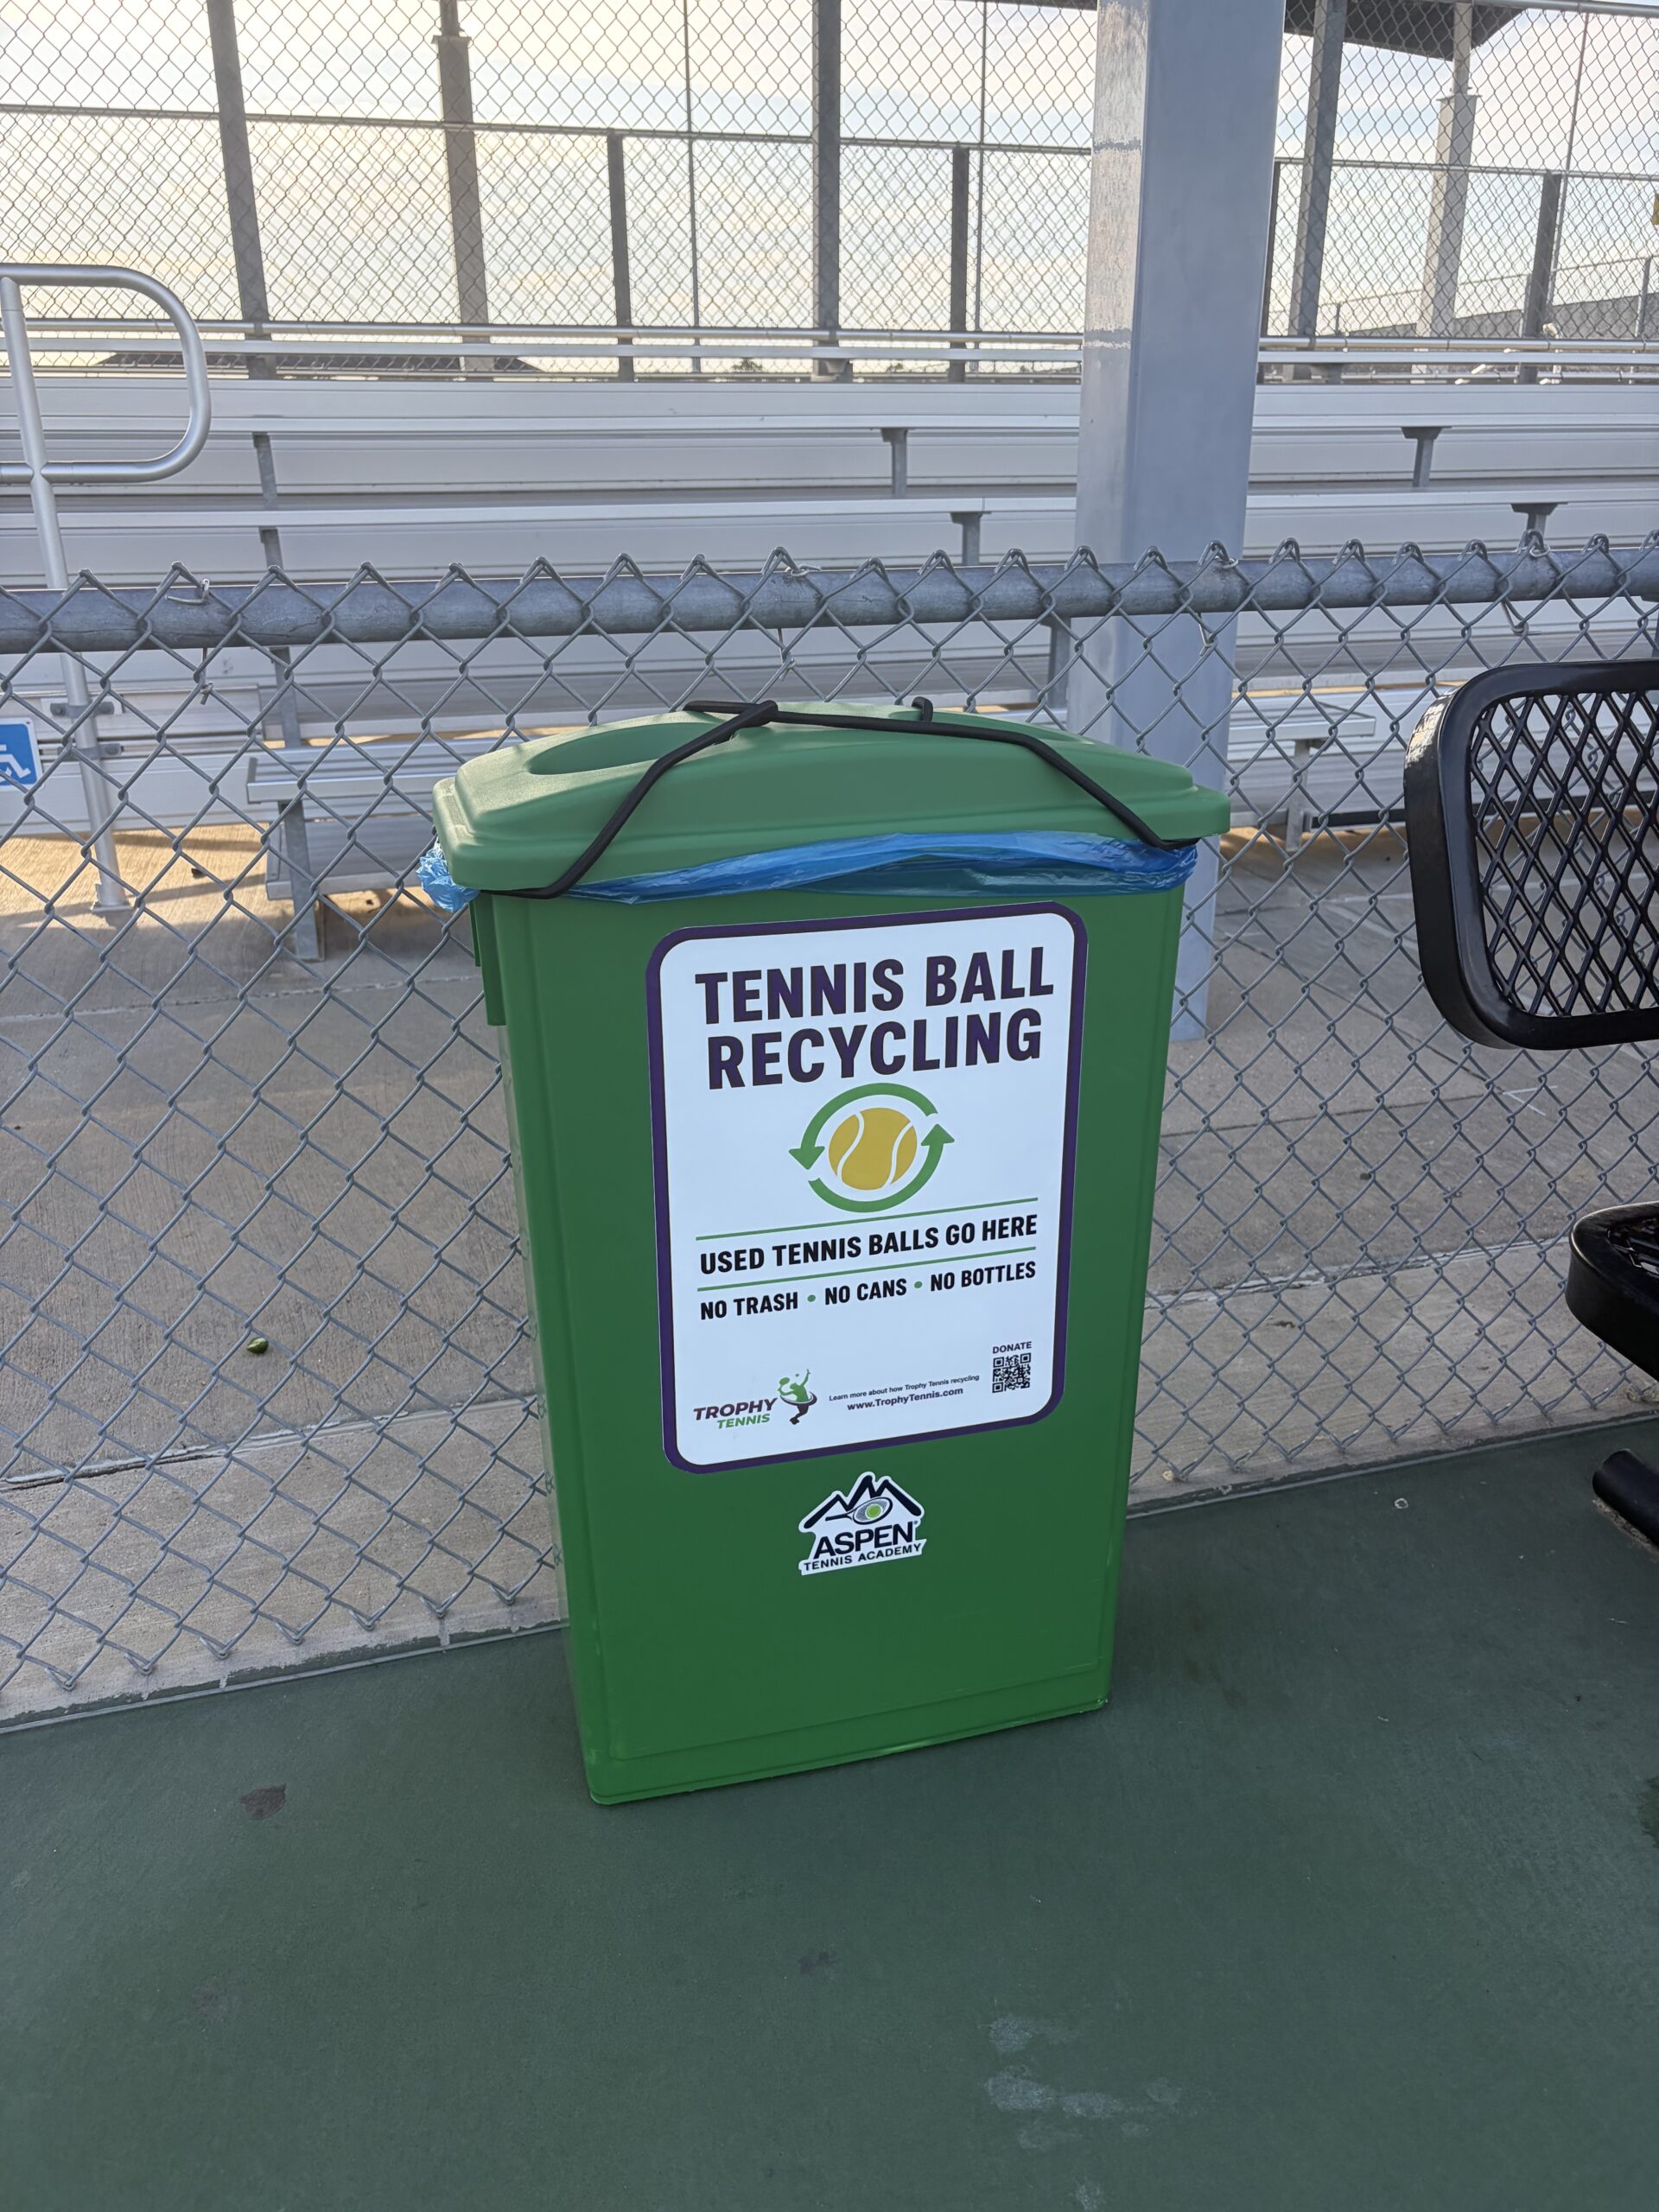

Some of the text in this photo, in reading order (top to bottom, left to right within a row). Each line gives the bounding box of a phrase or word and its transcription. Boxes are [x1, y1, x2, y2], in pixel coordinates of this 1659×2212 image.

[696, 947, 1053, 1024] TENNIS BALL
[708, 1007, 1041, 1090] RECYCLING
[700, 1214, 1038, 1274] USED TENNIS BALLS GO HERE
[701, 1261, 1037, 1320] NO TRASH NO CANS NO BOTTLES
[992, 1341, 1033, 1354] DONATE
[829, 1393, 849, 1402] Learn
[849, 1390, 867, 1399] more
[868, 1387, 887, 1396] about
[905, 1382, 927, 1391] Trophy
[928, 1378, 950, 1388] Tennis
[950, 1374, 980, 1384] recycling
[847, 1388, 963, 1411] www.TrophyTennis.com
[694, 1397, 778, 1421] TROPHY
[717, 1414, 770, 1428] TENNIS
[813, 1522, 913, 1560] ASPEN
[804, 1543, 922, 1571] TENNIS ACADEMY
